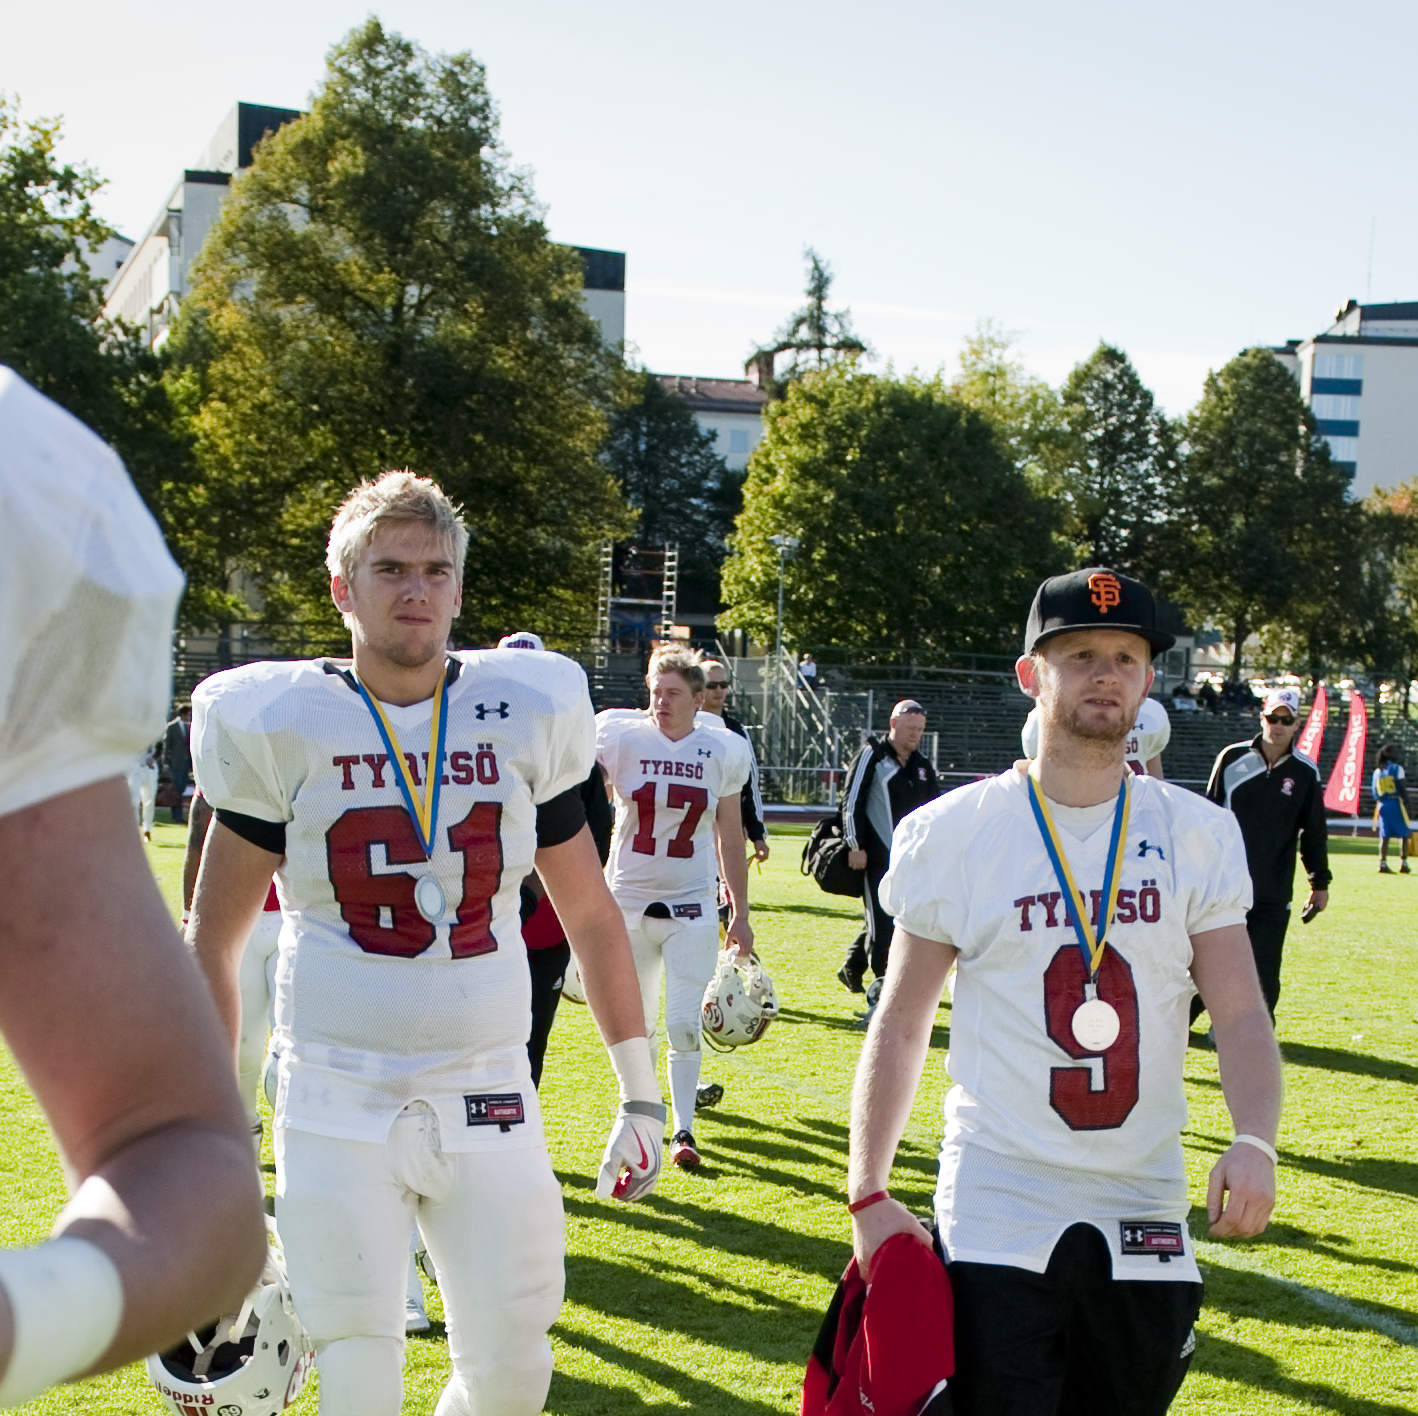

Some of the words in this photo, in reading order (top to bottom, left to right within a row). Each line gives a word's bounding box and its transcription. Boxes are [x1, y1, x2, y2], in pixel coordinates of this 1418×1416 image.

[640, 760, 703, 780] TYRESÖ
[632, 782, 708, 858] 17
[325, 802, 504, 960] 61
[1043, 944, 1140, 1131] 9
[155, 1380, 215, 1406] Riddell
